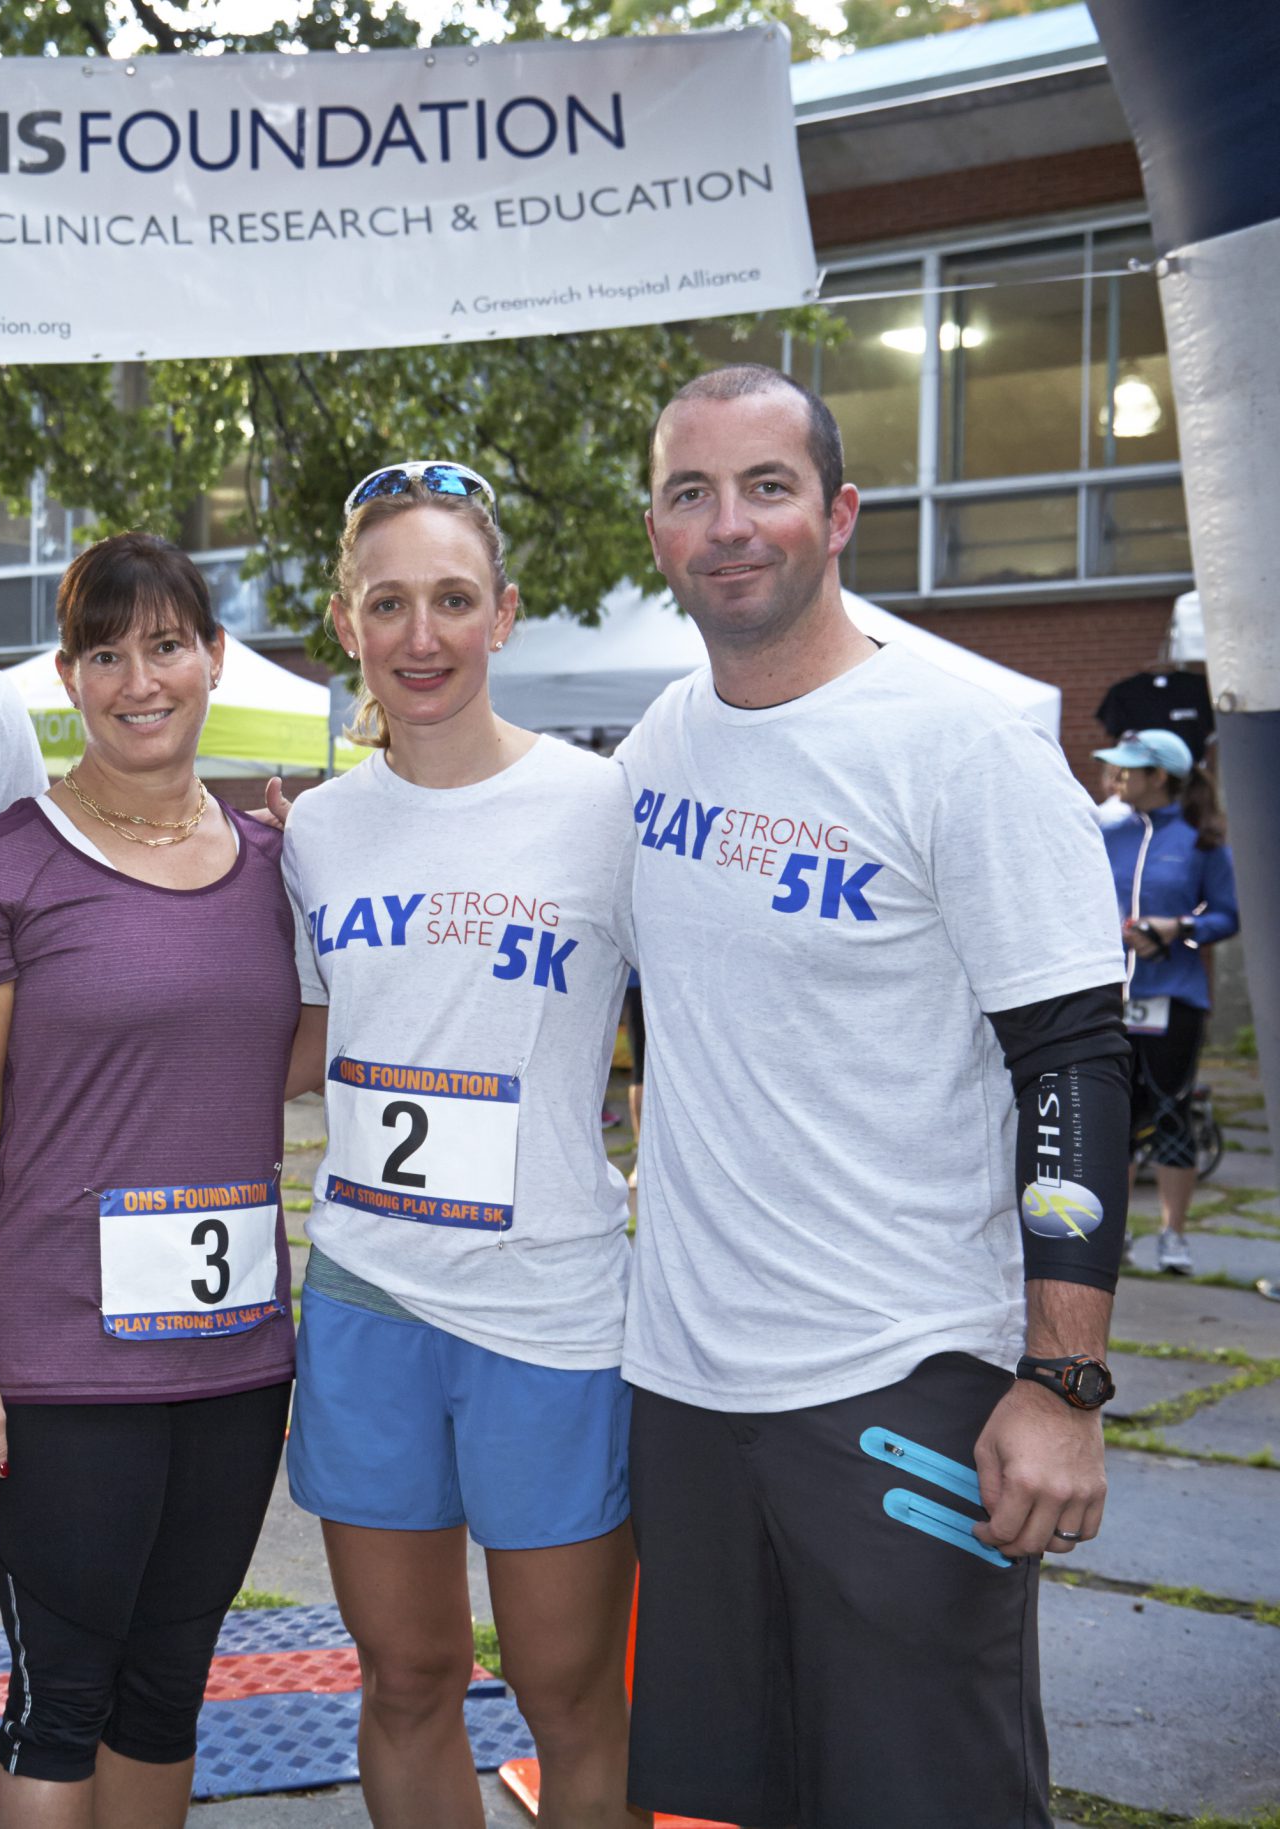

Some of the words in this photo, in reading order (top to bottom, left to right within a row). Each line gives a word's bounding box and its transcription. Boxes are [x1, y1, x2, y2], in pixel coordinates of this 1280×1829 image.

[210, 206, 432, 244] RESEARCH
[451, 203, 479, 231] &
[497, 163, 773, 228] EDUCATION
[451, 299, 467, 315] A
[473, 286, 581, 314] Greenwich
[588, 275, 670, 303] Hospital
[677, 266, 760, 291] Alliance
[634, 788, 724, 860] PLAY
[721, 809, 849, 853] STRONG
[716, 840, 778, 876] SAFE
[772, 853, 885, 921] 5K
[429, 891, 560, 927] STRONG
[427, 920, 494, 946] SAFE
[492, 924, 579, 994] 5K
[340, 1060, 366, 1084] ONS
[370, 1066, 498, 1097] FOUNDATION
[381, 1100, 429, 1189] 2
[1072, 1113, 1082, 1147] HEALTH
[1073, 1153, 1083, 1178] ELITE
[124, 1191, 167, 1211] ONS
[173, 1184, 267, 1209] FOUNDATION
[335, 1181, 355, 1200] PLAY
[358, 1188, 399, 1210] STRONG
[403, 1197, 437, 1215] PLAY
[441, 1204, 478, 1220] SAFE
[484, 1208, 504, 1222] 5K
[191, 1219, 230, 1305] 3
[114, 1317, 151, 1332] PLAY
[156, 1315, 213, 1331] STRONG
[216, 1311, 237, 1328] PLAY
[239, 1307, 263, 1323] SAFE
